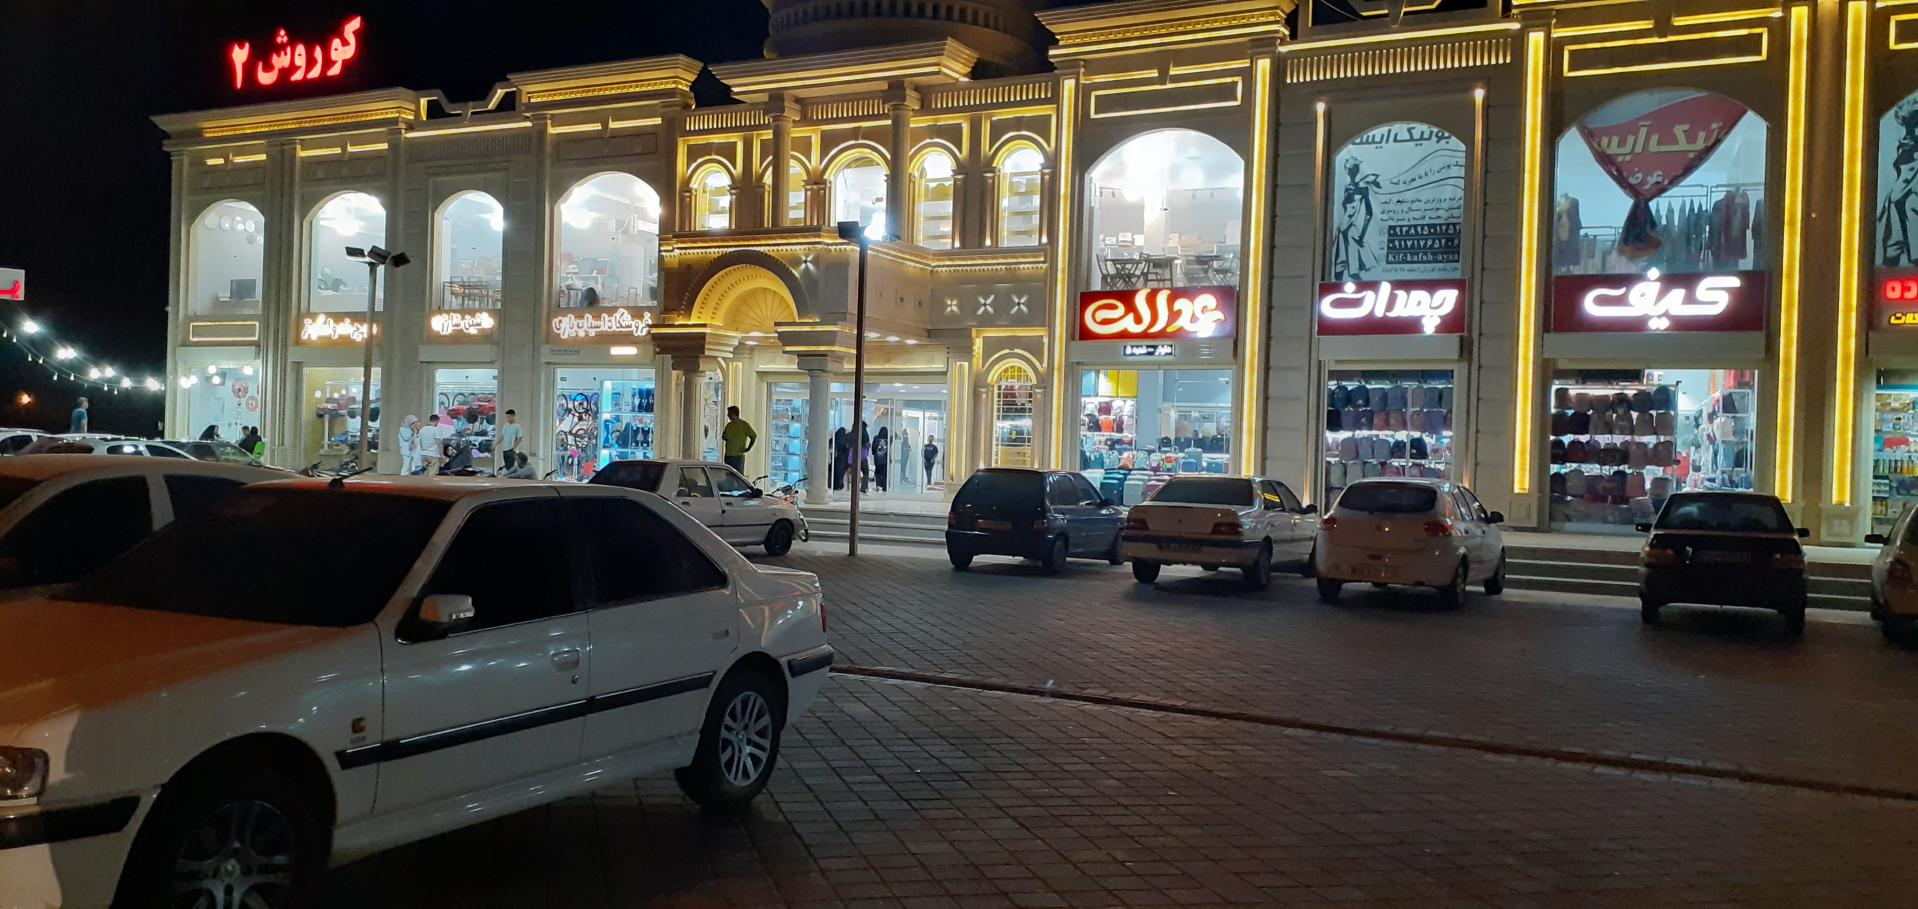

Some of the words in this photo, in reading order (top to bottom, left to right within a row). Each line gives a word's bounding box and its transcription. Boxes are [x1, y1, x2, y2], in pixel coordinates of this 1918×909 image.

[231, 41, 250, 90] ۲
[257, 15, 361, 85] کوروش
[1085, 288, 1226, 338] عدالت
[1320, 281, 1459, 335] چمدان
[1584, 267, 1741, 330] کیف
